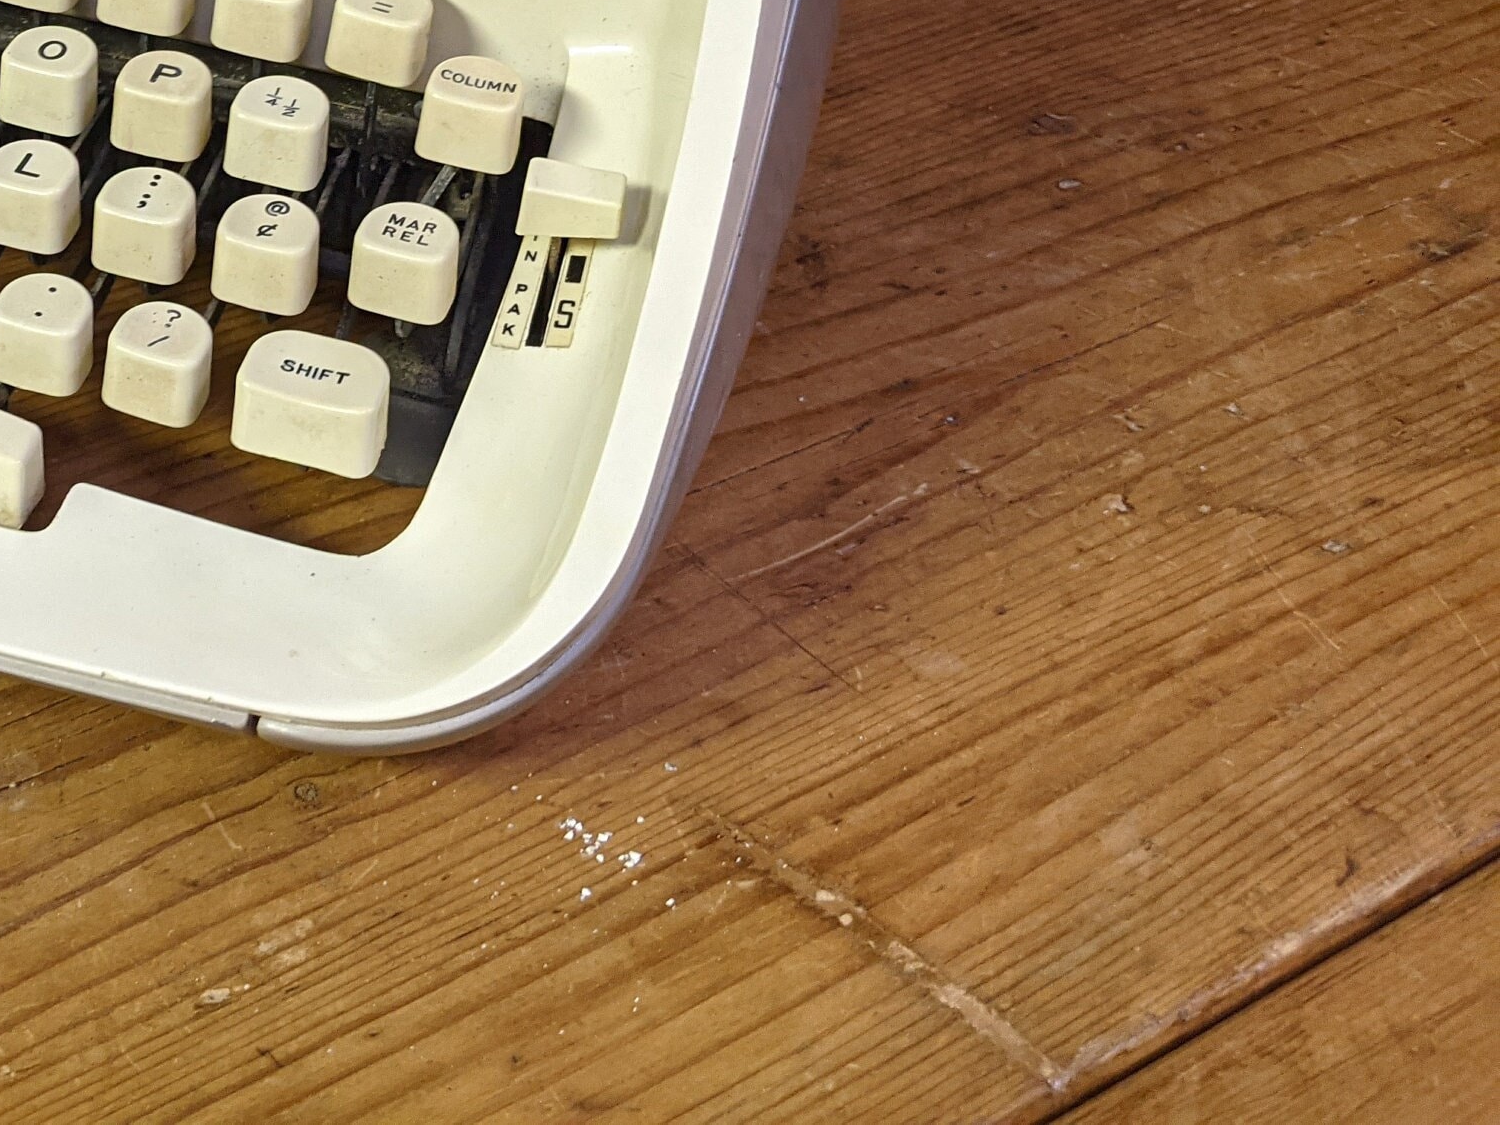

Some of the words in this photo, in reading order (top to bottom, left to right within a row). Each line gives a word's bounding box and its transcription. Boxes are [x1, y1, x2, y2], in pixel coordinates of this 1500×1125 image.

[371, 1, 394, 14] =
[37, 40, 68, 61] O
[149, 63, 183, 83] P
[440, 68, 518, 94] COLUMN
[14, 152, 40, 178] L
[265, 200, 291, 217] @
[387, 213, 438, 234] MAR
[381, 225, 429, 247] REL
[164, 309, 182, 328] ?
[553, 300, 576, 329] S
[280, 359, 351, 385] SHIFT
